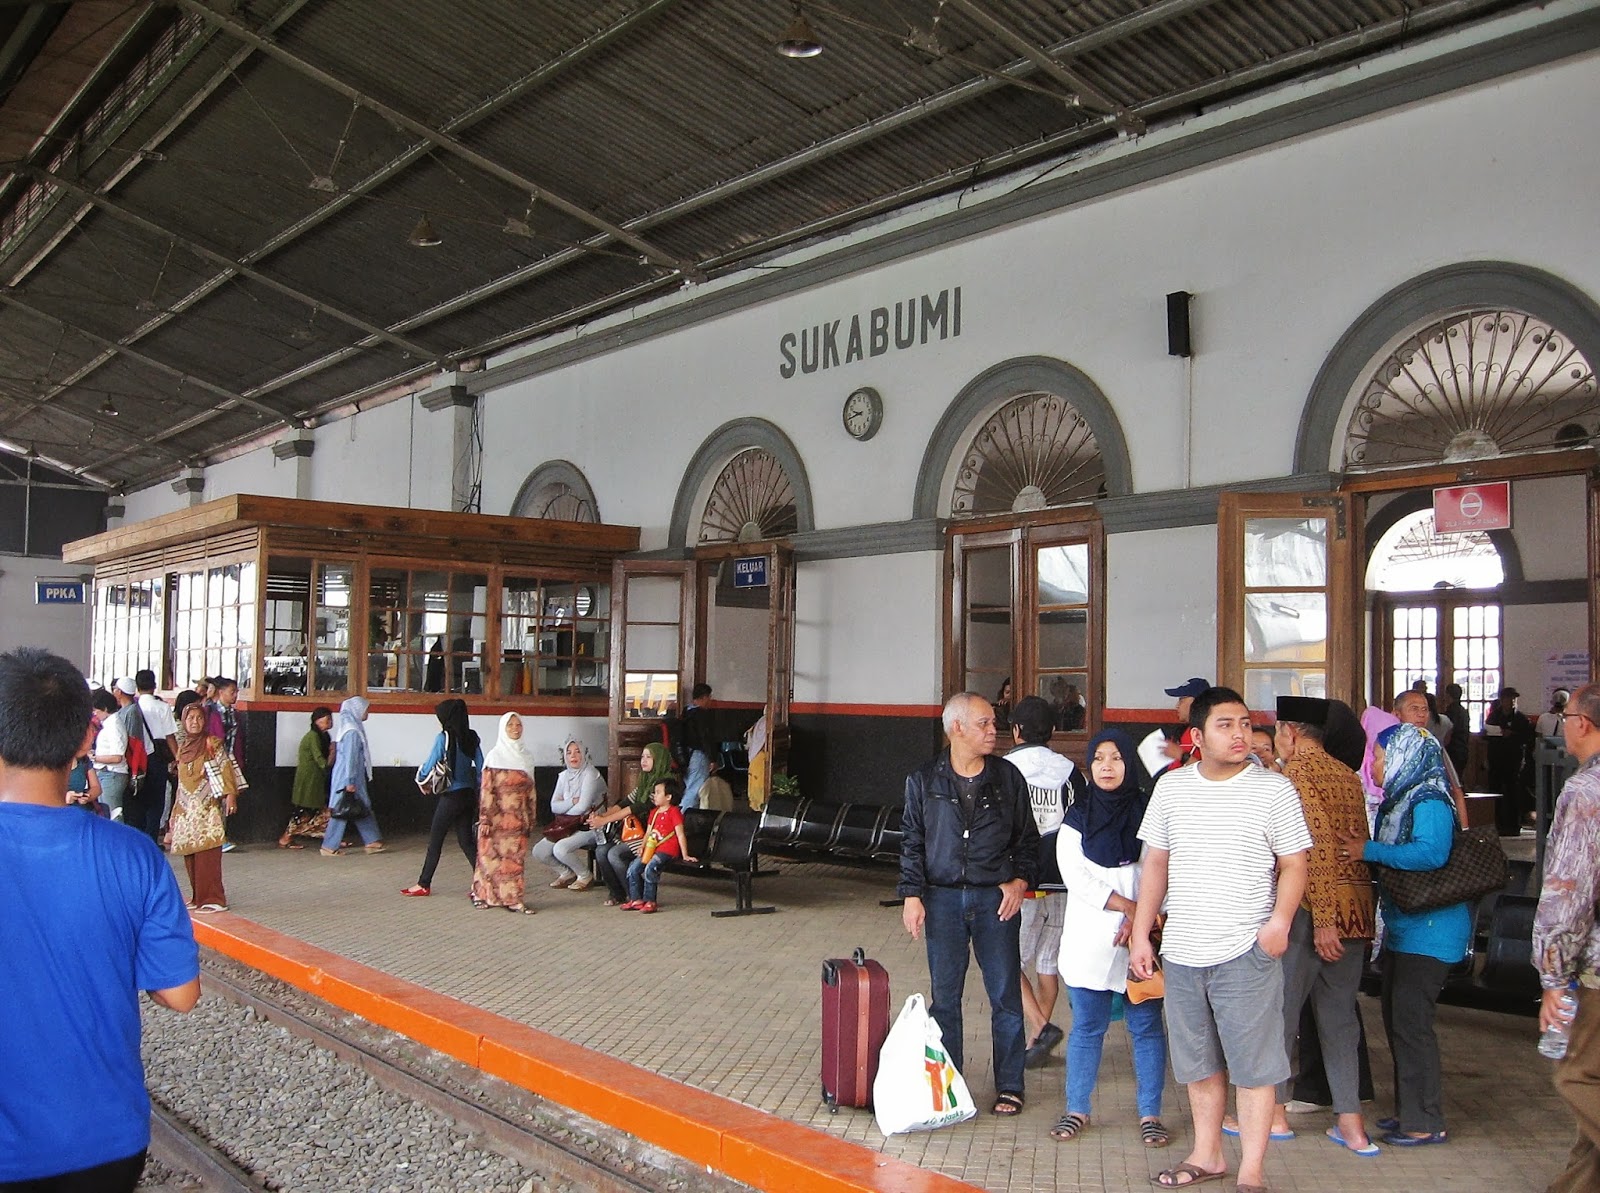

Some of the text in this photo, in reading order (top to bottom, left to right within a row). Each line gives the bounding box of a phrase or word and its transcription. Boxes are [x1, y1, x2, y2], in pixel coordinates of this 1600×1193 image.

[780, 286, 962, 379] SUKABUMI
[736, 561, 764, 574] KELUAR
[46, 587, 76, 599] PPKA
